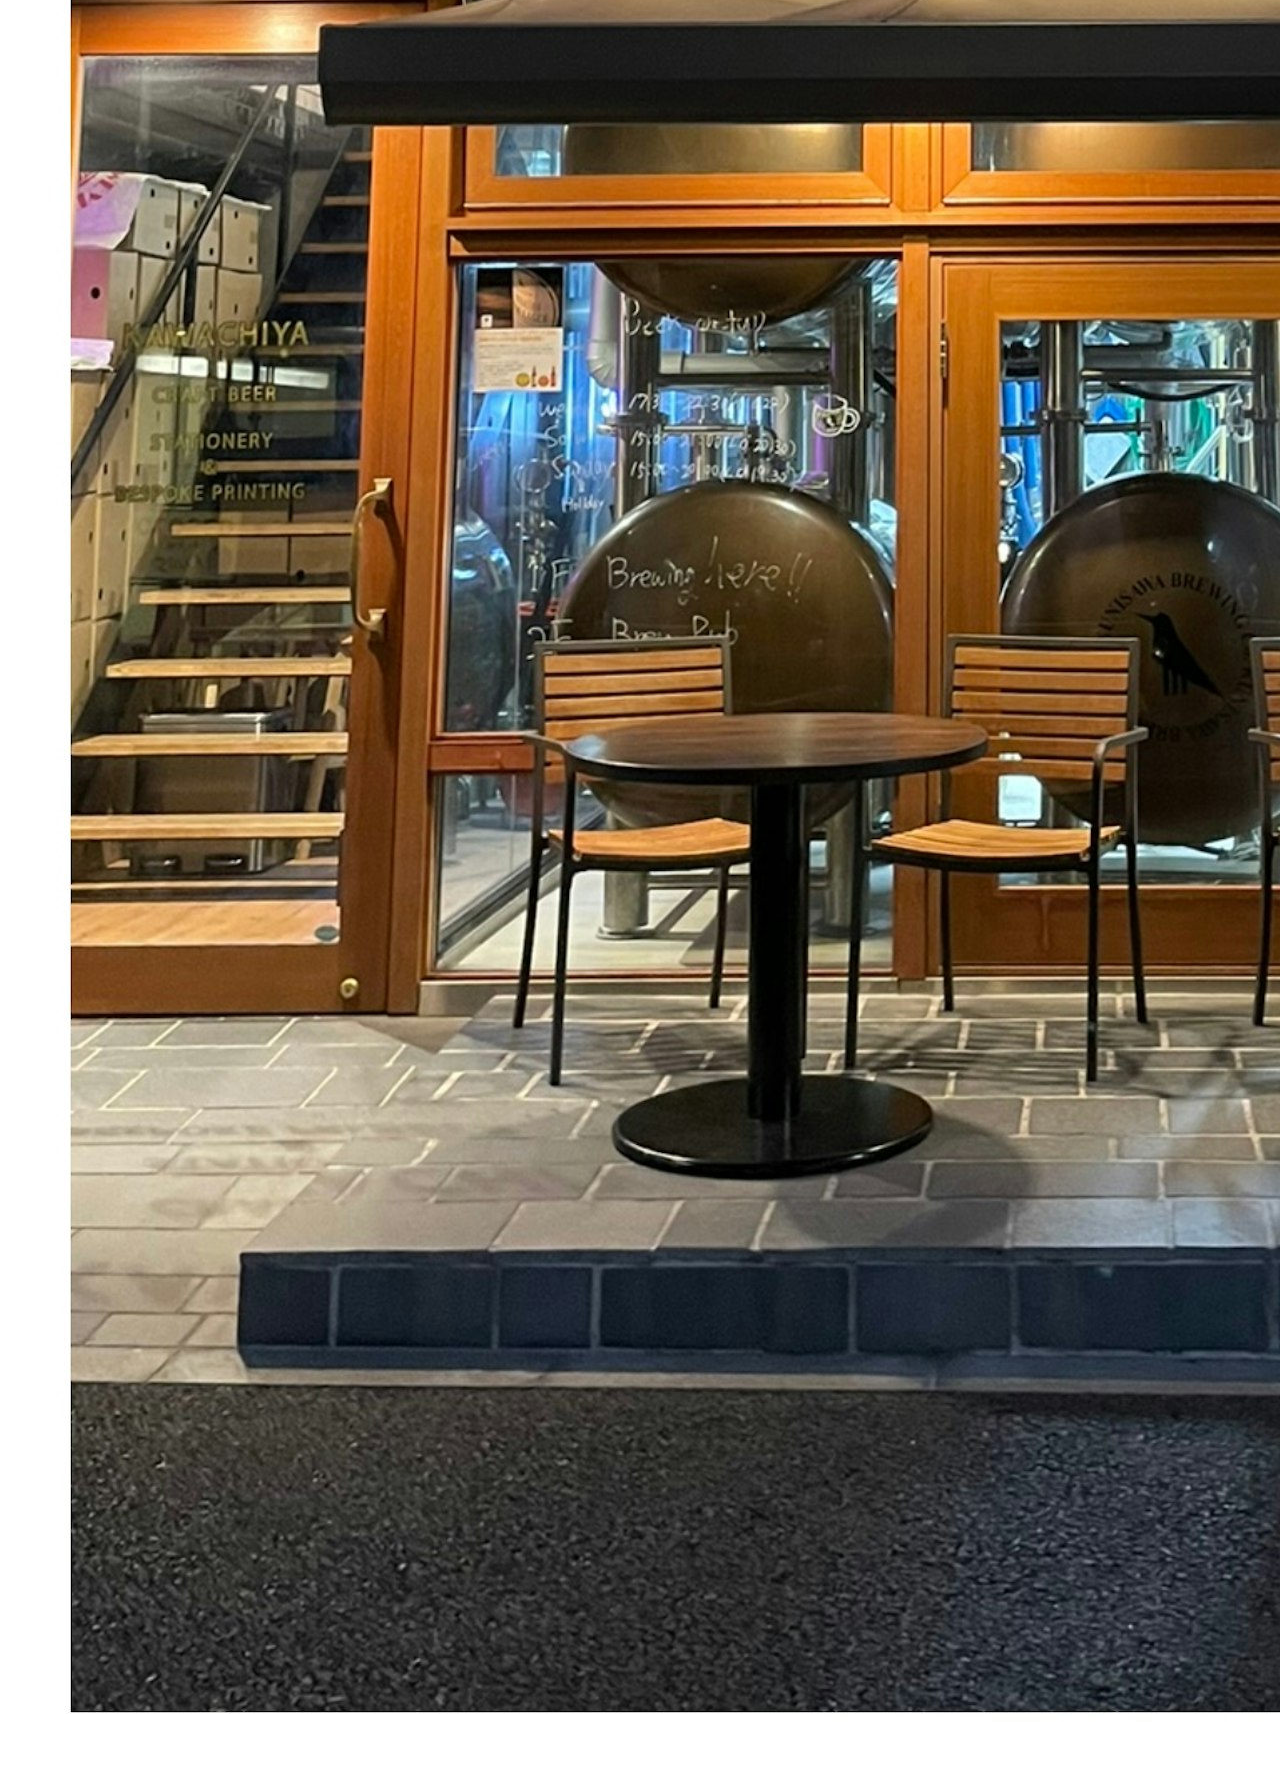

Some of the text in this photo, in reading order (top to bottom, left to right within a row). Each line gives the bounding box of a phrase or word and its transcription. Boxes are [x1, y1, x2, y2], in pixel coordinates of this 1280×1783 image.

[122, 319, 310, 348] KAWACHIYA
[227, 385, 277, 402] BEER
[149, 431, 274, 452] STATIONERY
[114, 482, 306, 504] BESPOKE PRINTING
[606, 555, 698, 606] Brewing
